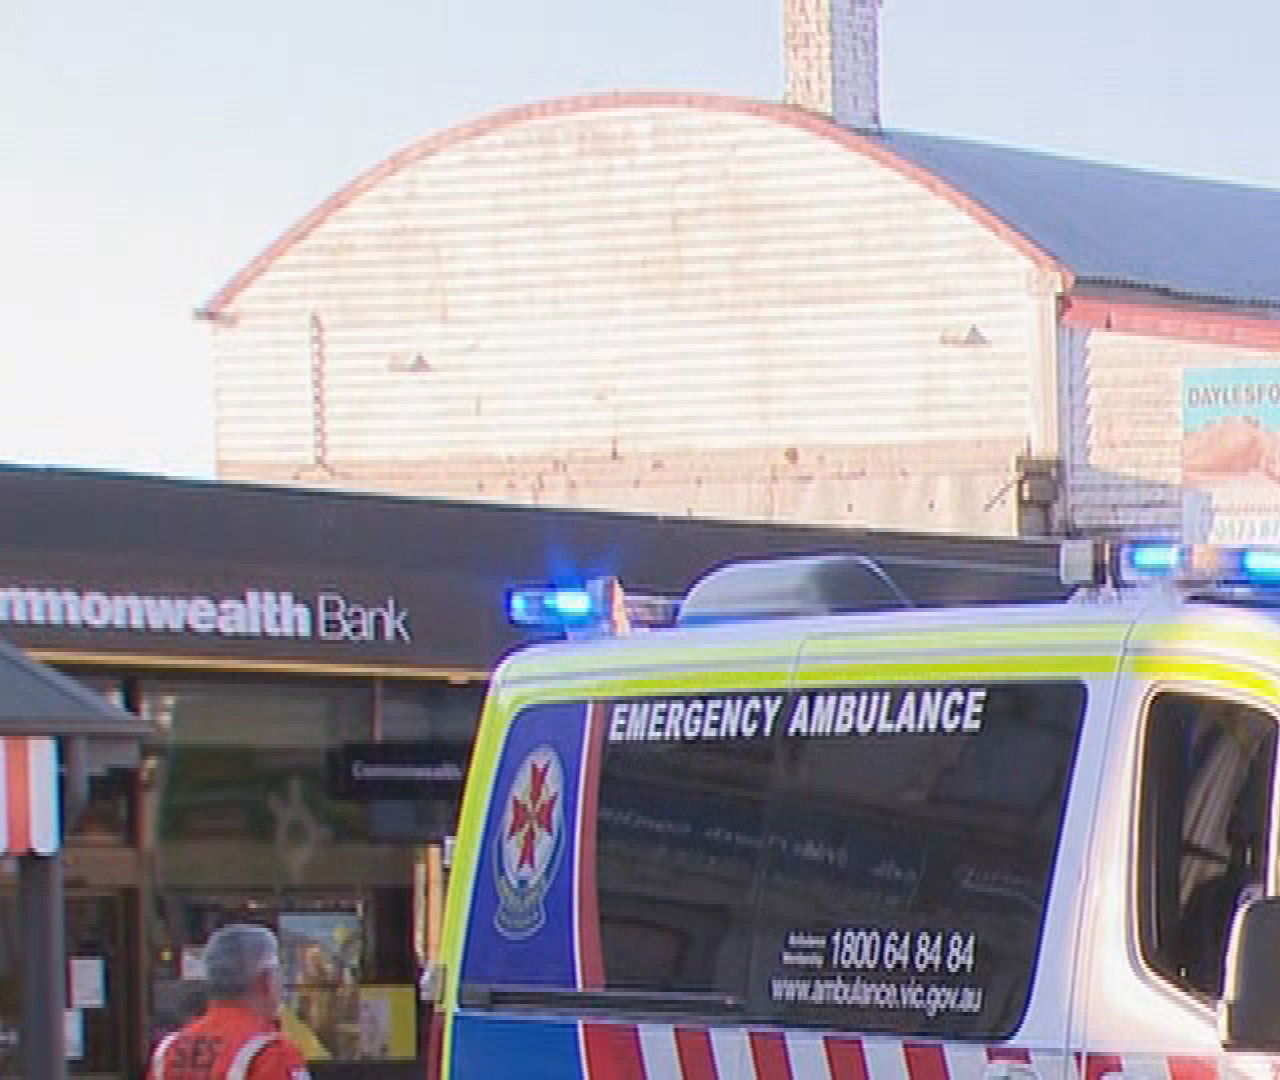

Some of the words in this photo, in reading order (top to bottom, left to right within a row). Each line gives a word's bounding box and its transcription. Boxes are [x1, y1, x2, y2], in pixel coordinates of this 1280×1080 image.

[317, 593, 412, 643] Bank
[606, 696, 783, 741] EMERGENCY
[788, 688, 987, 736] AMBULANCE
[832, 930, 881, 970] 1800
[884, 930, 911, 972] 64
[915, 930, 943, 973] 84
[947, 930, 976, 974] 84
[770, 974, 984, 1018] www.ambulance.vic.gov.au
